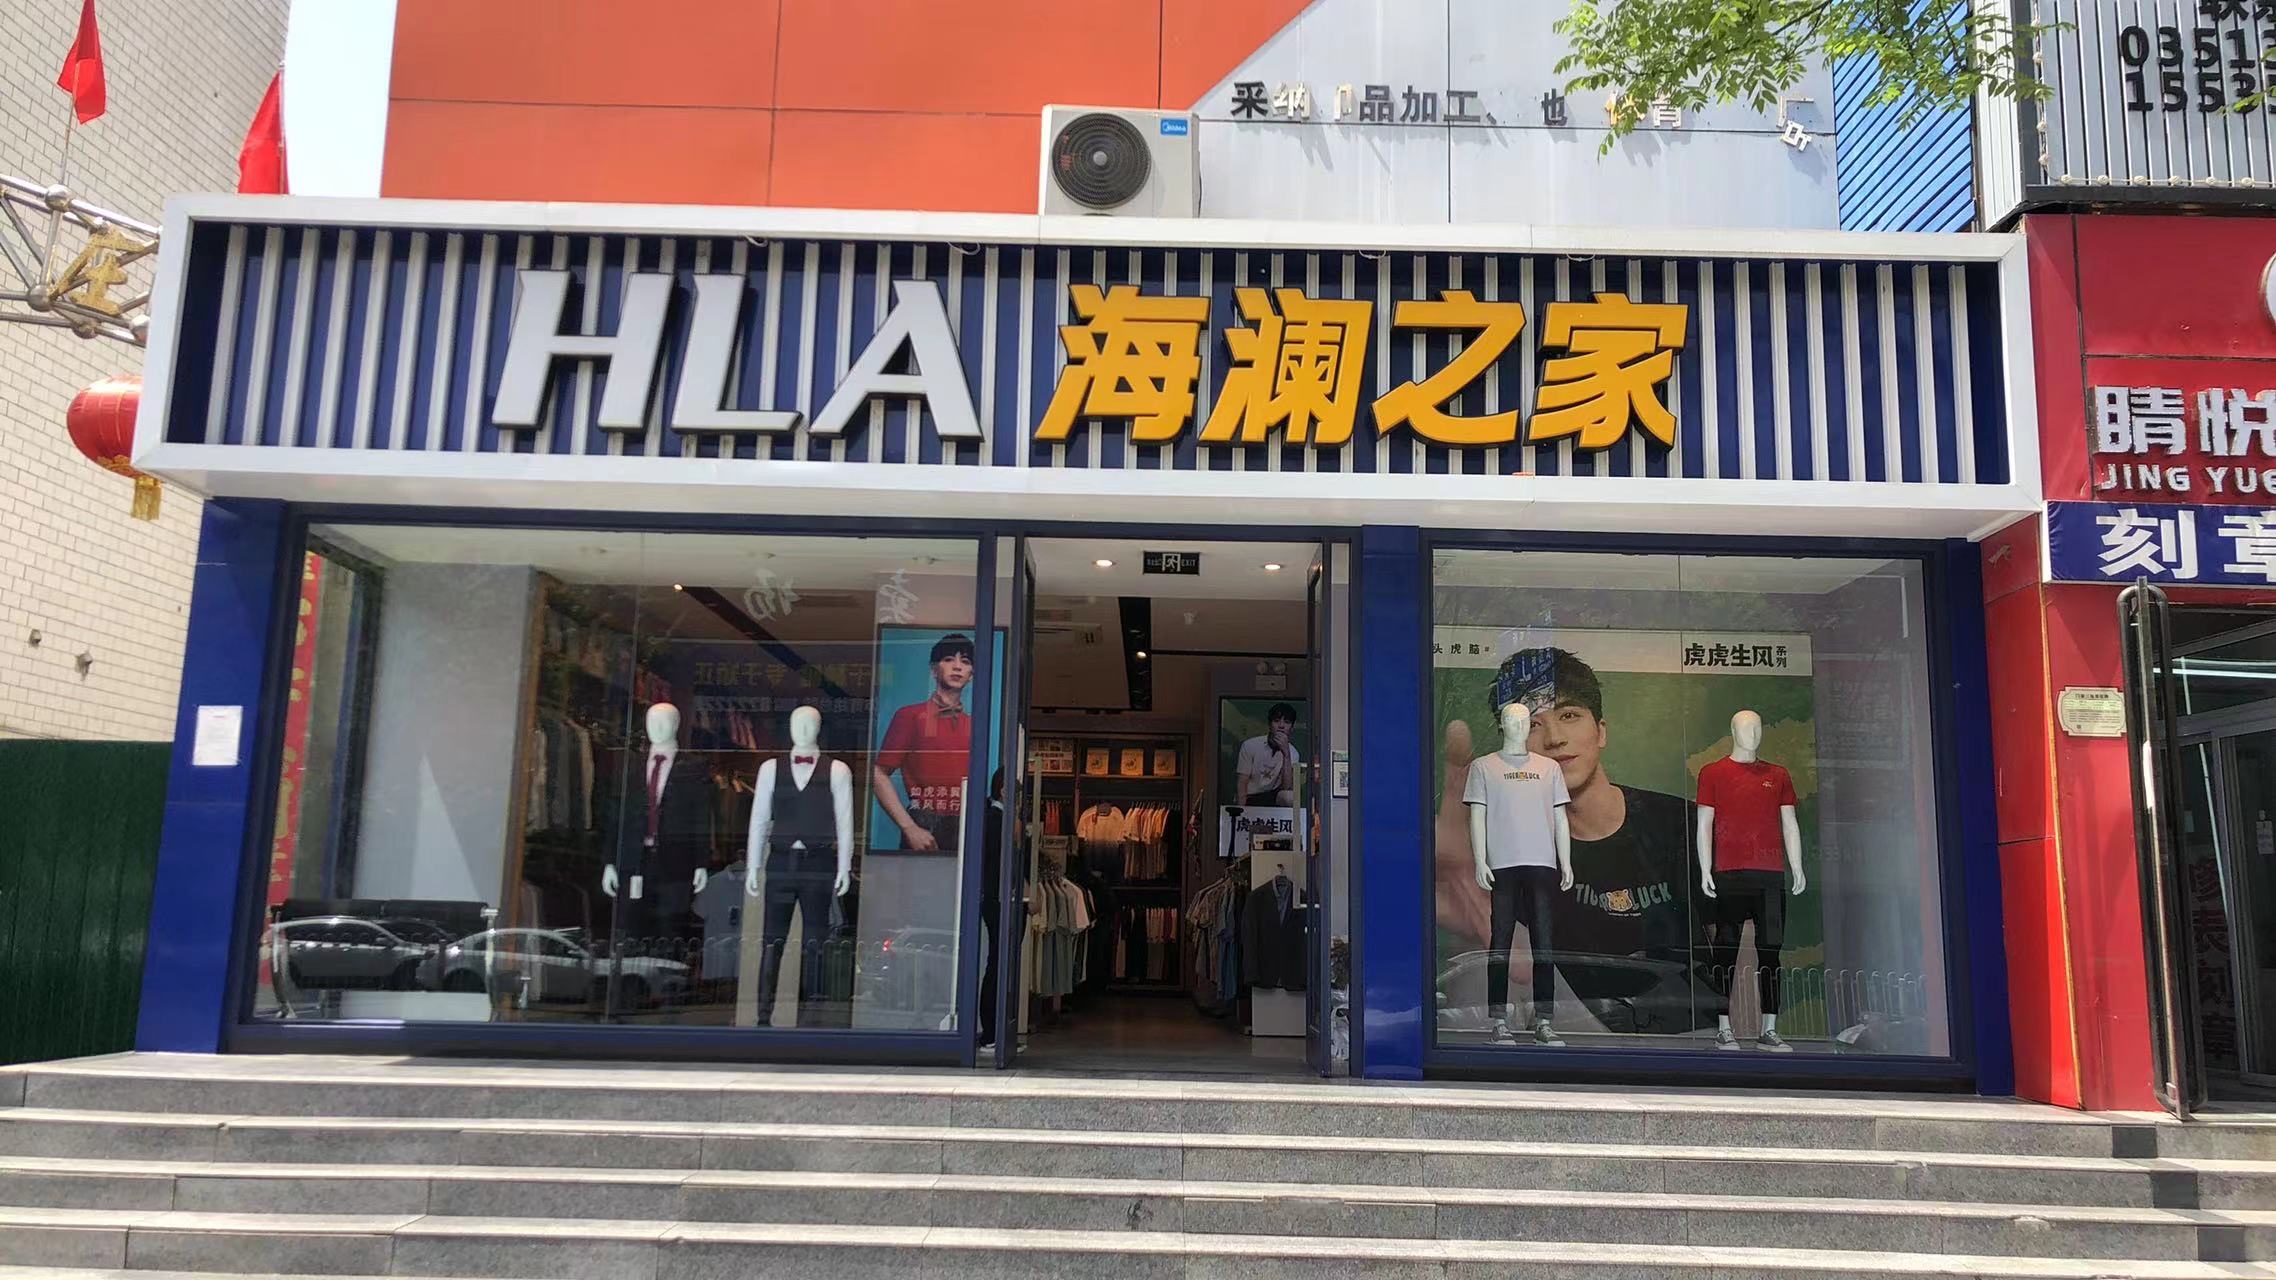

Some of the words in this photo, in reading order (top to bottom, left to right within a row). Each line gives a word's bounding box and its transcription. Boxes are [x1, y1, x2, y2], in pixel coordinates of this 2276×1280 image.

[491, 269, 984, 442] HLA
[1033, 283, 1689, 453] 海澜之家
[2100, 463, 2191, 492] JING
[2095, 508, 2276, 584] 刻章
[1684, 642, 1774, 668] 虎虎生风
[1628, 881, 1673, 911] LUCK
